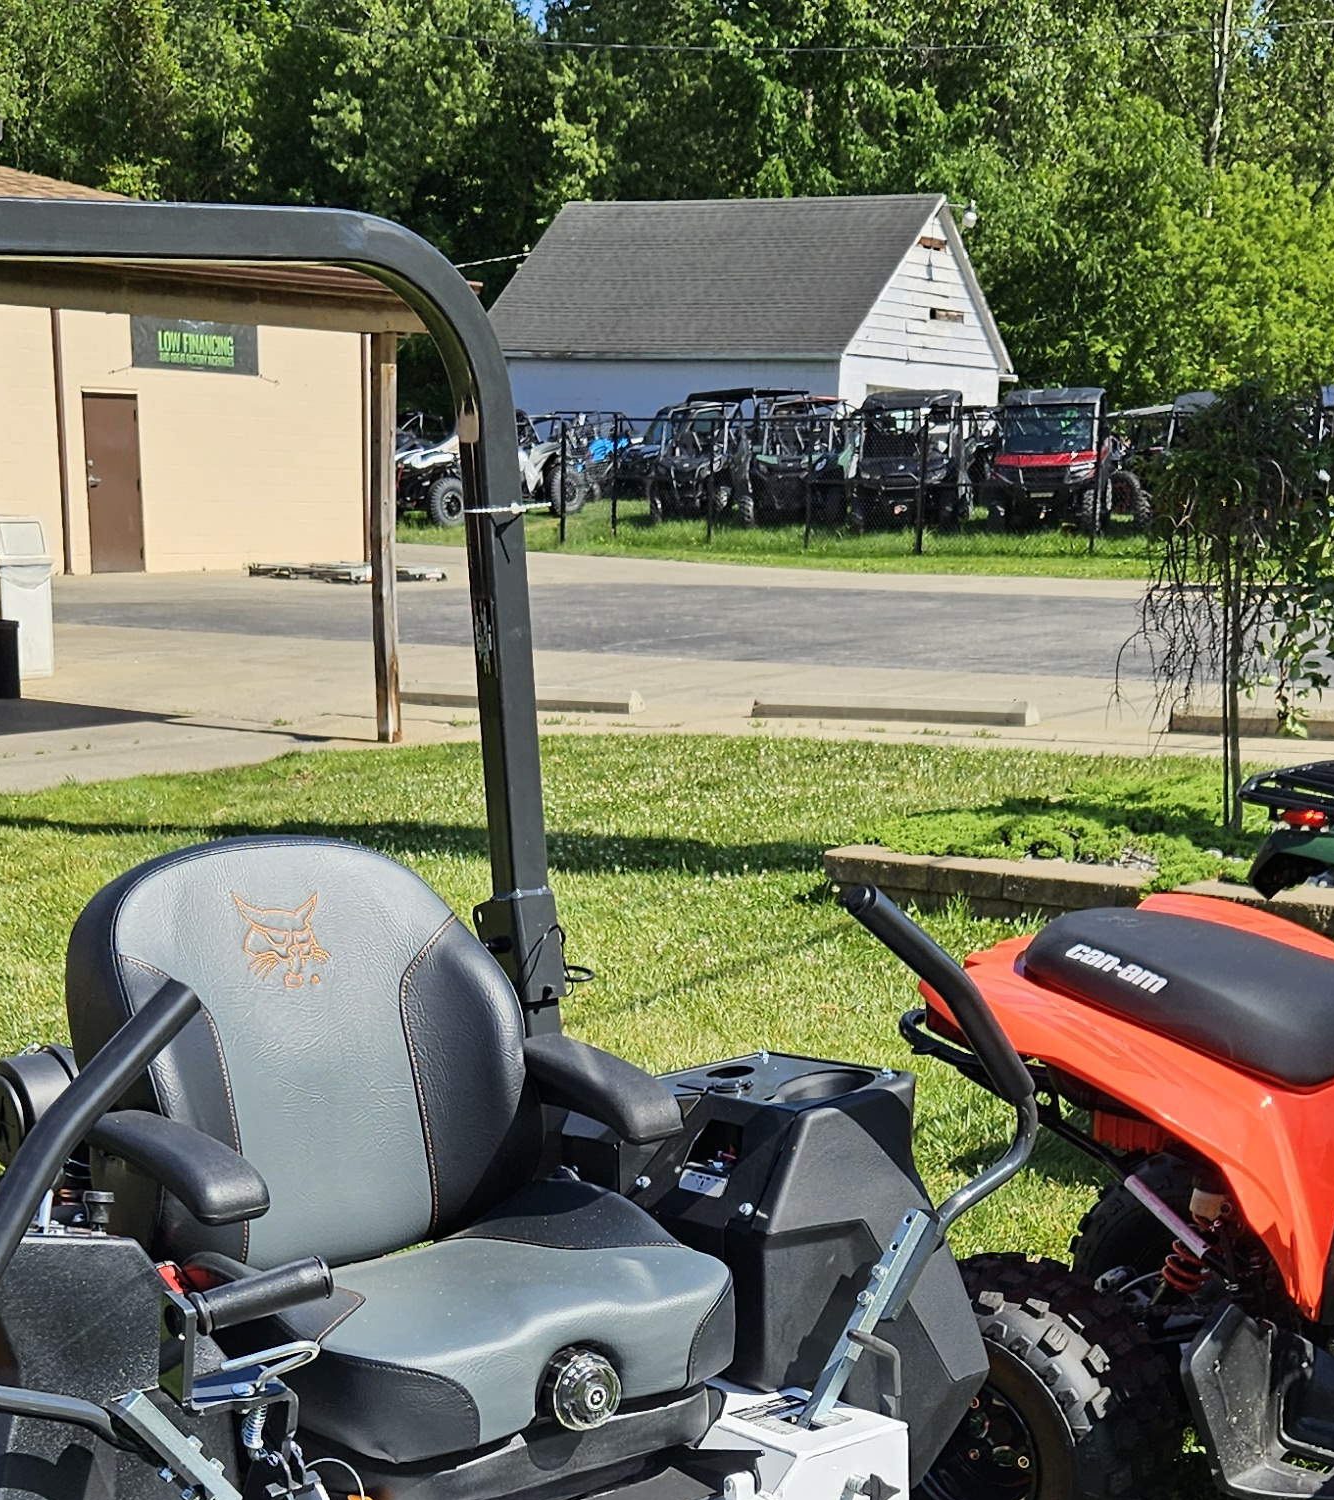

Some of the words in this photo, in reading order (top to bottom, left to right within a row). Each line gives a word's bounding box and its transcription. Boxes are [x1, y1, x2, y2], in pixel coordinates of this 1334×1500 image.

[158, 330, 181, 352] LOW
[182, 333, 235, 356] FINANCING
[1064, 942, 1170, 996] can-am
